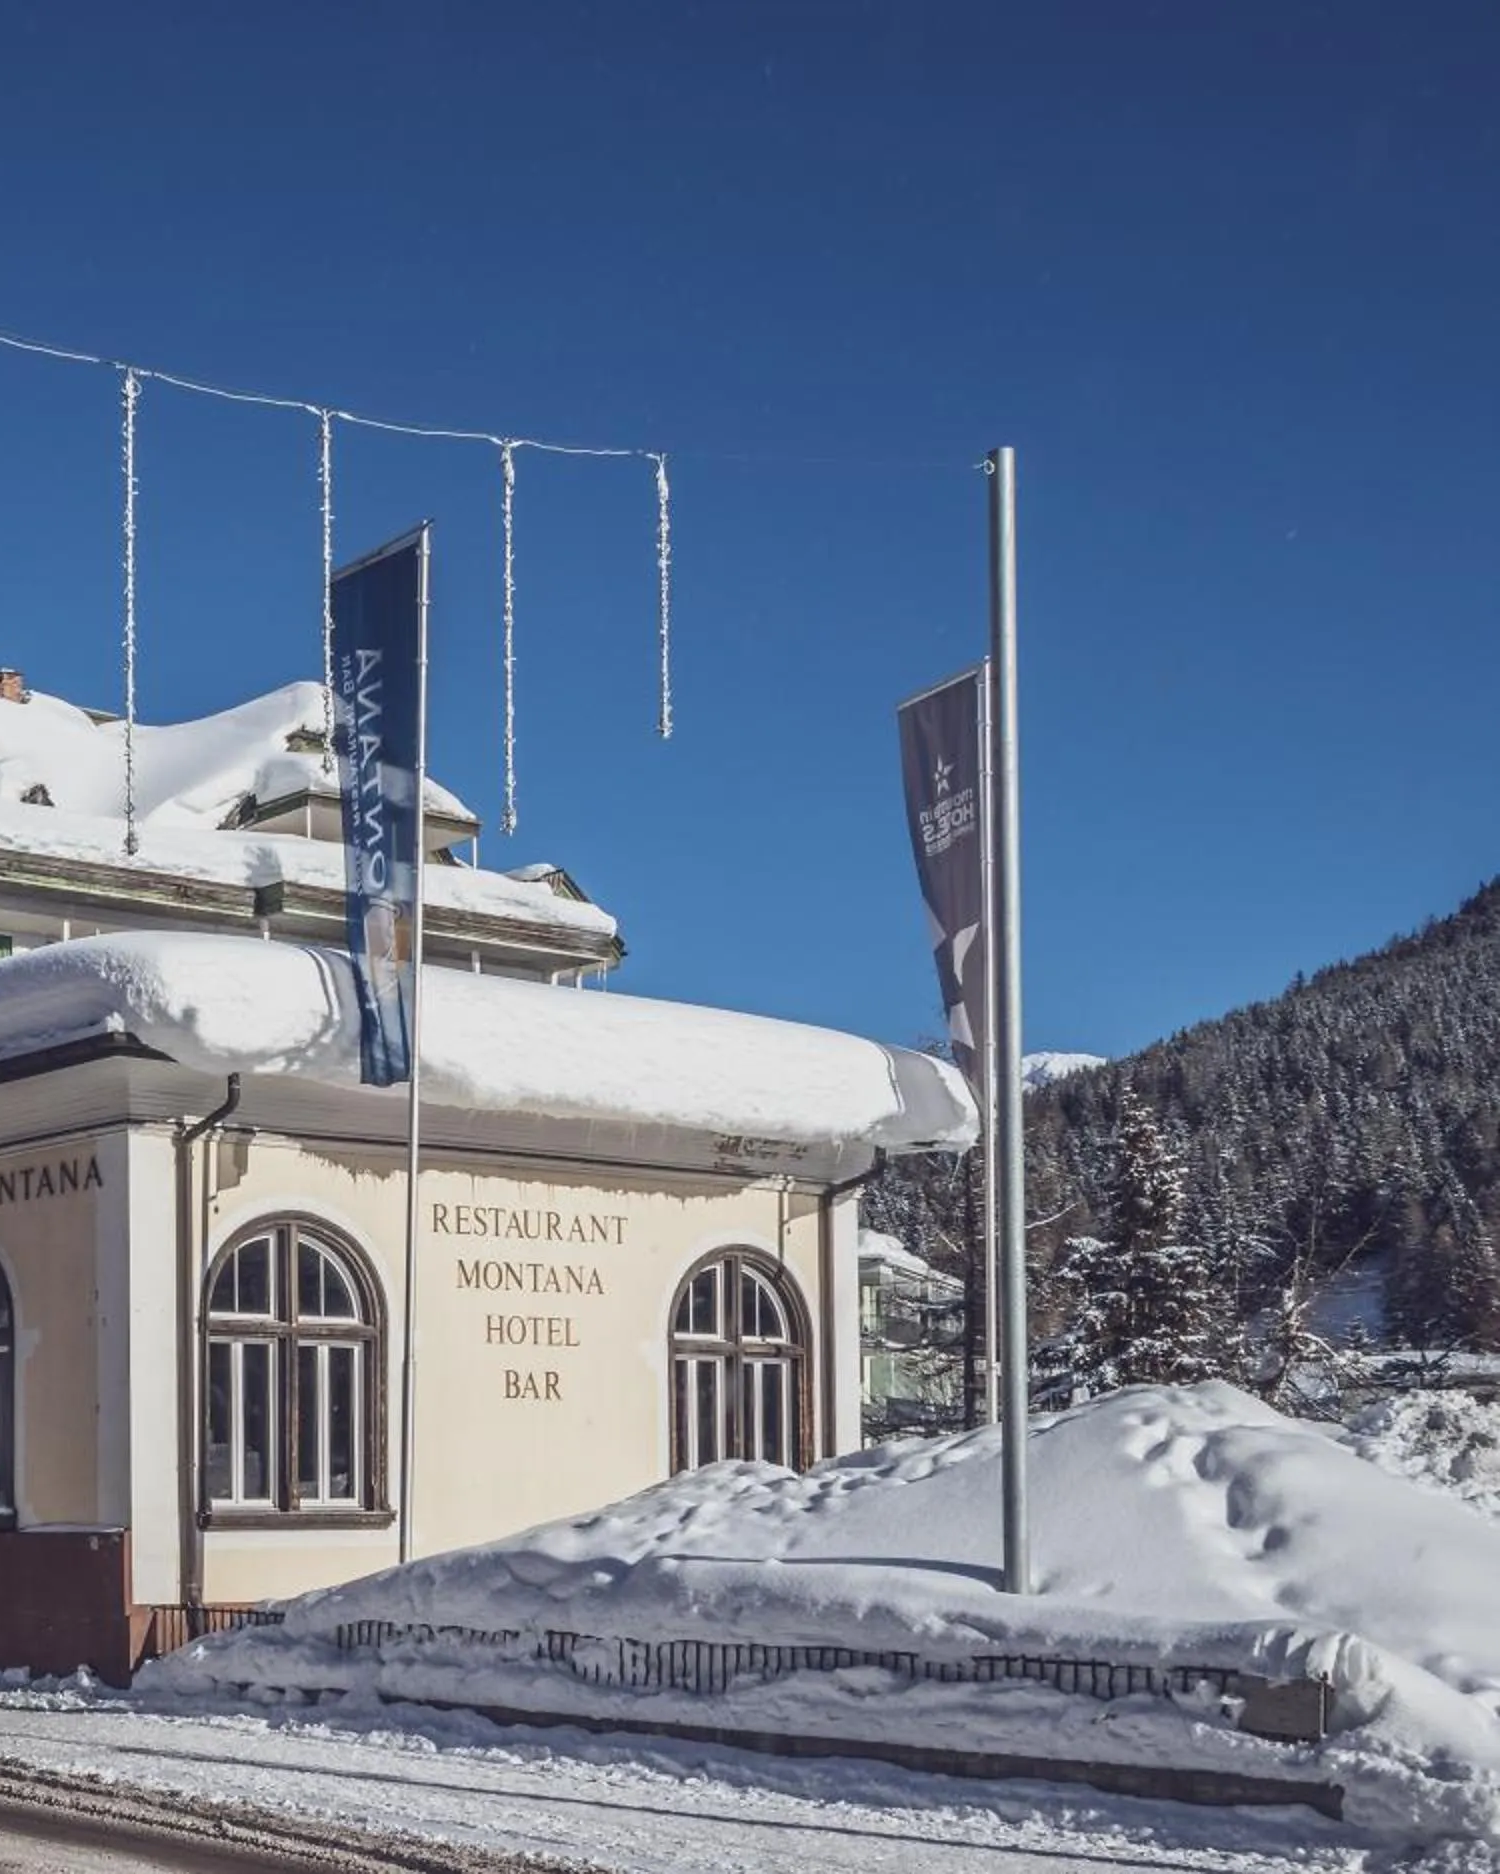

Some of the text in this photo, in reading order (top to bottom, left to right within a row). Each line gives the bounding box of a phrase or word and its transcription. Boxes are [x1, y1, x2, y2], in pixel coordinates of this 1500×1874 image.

[432, 1203, 629, 1245] RESTAURANT
[456, 1259, 604, 1295] MONTANA
[486, 1315, 581, 1347] HOTEL
[504, 1369, 563, 1400] BAR
